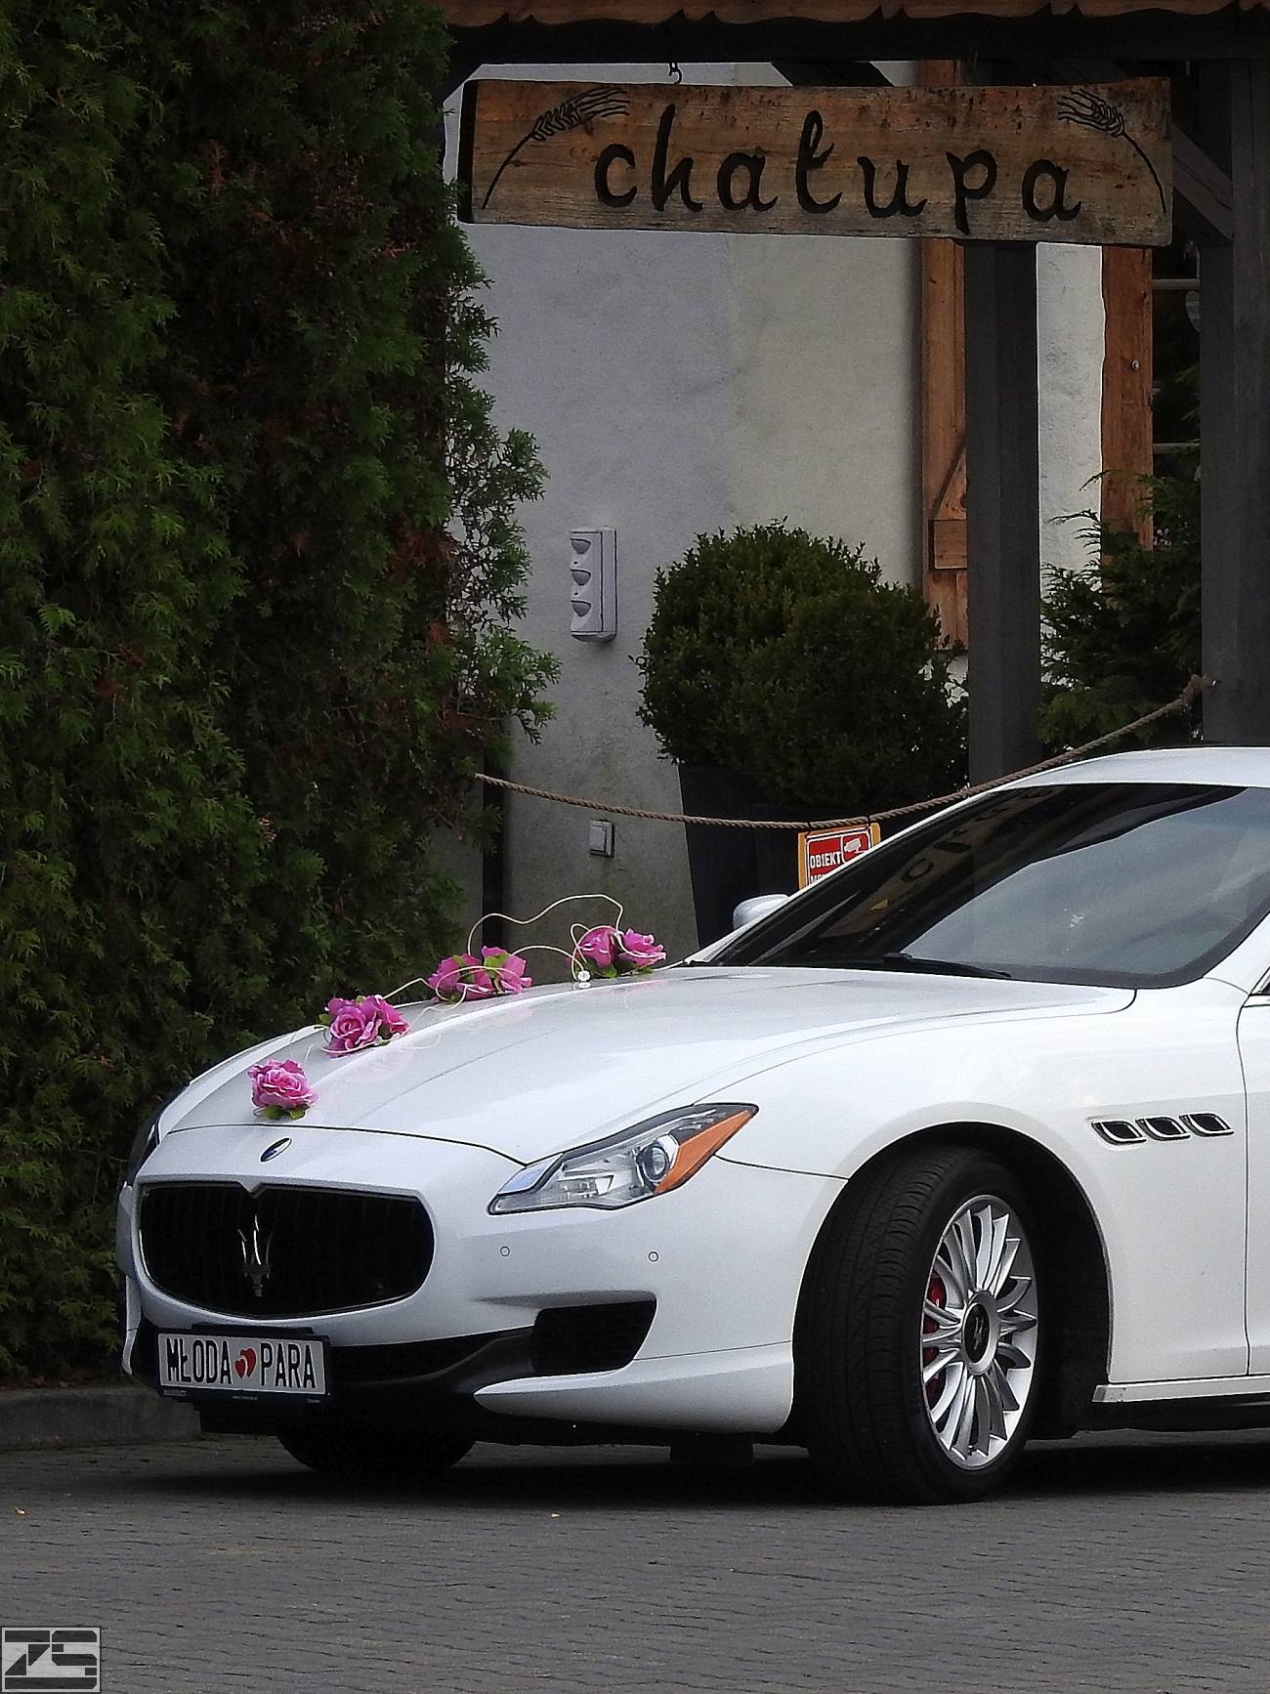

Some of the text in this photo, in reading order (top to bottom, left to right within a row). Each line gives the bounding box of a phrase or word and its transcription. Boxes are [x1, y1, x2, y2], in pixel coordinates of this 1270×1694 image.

[809, 851, 842, 869] OBIEKT
[166, 1338, 316, 1389] MŁODA PARA
